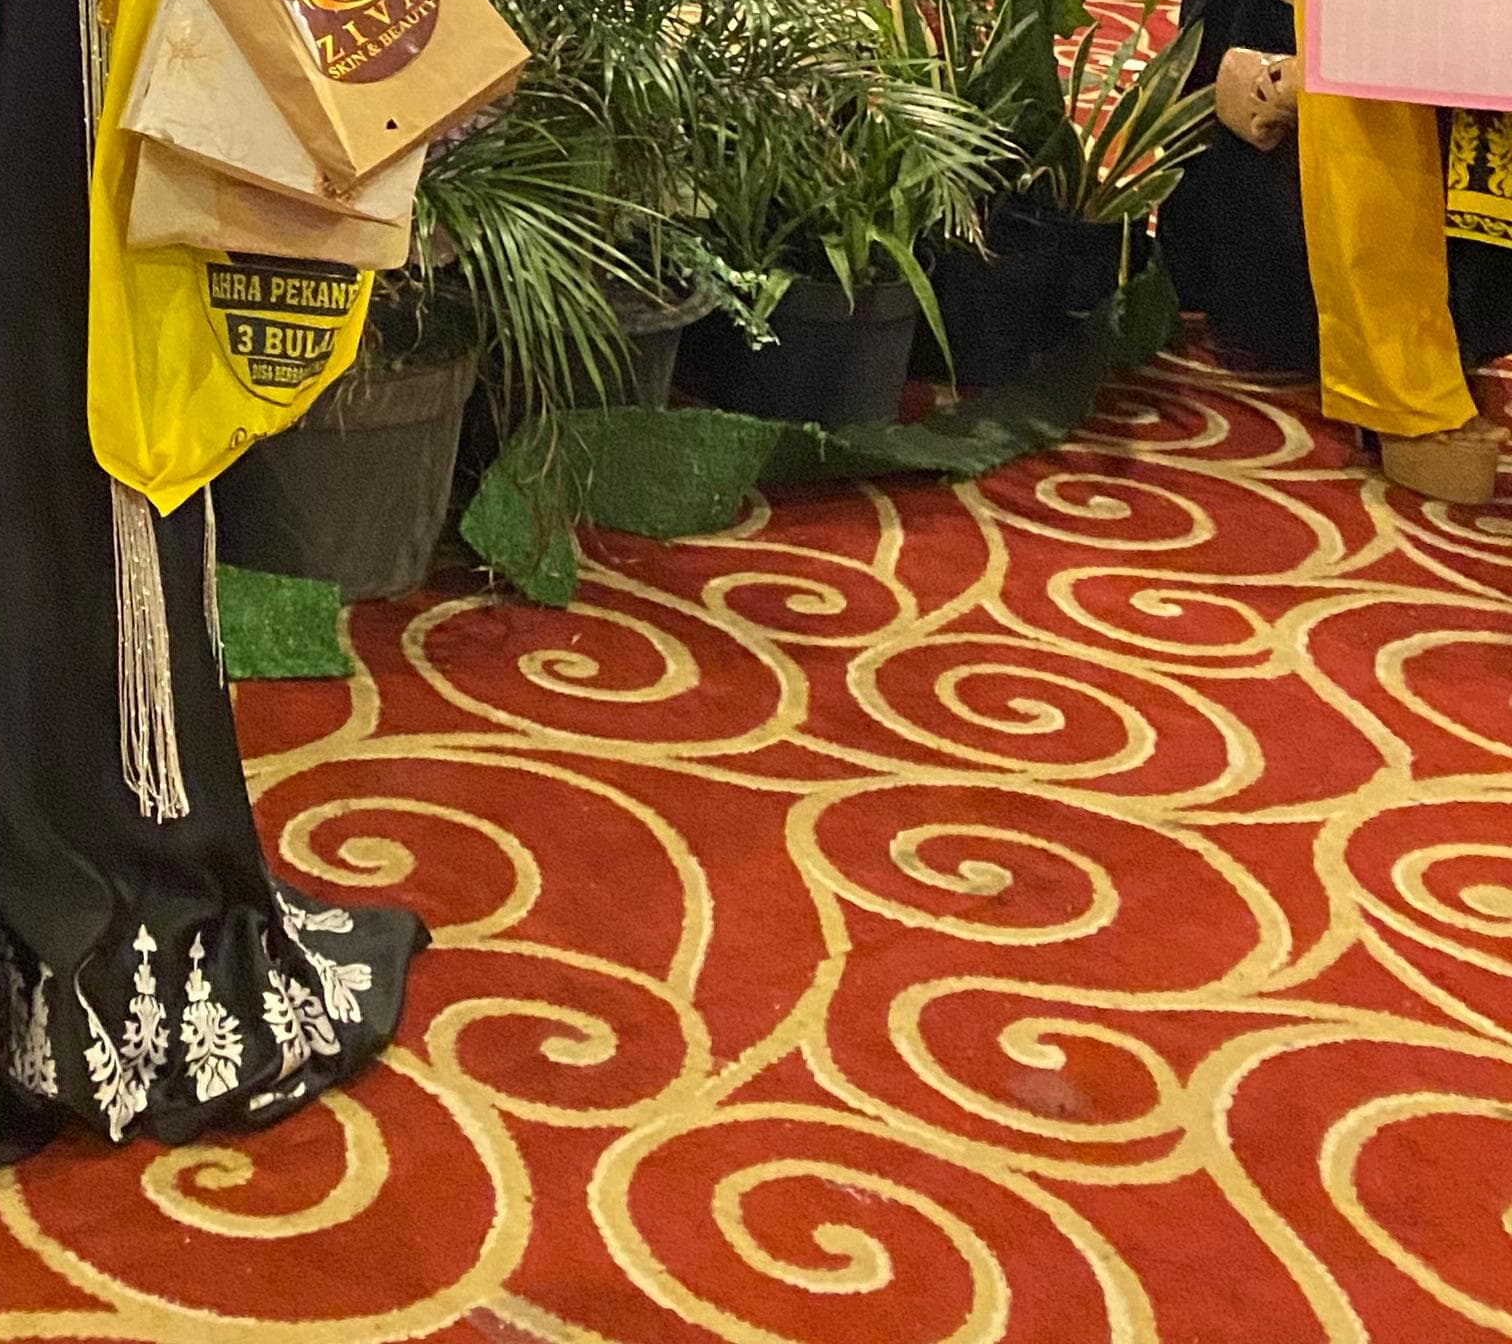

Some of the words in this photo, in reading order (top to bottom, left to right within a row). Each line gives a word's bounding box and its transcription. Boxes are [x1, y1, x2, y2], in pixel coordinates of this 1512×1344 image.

[329, 50, 369, 79] SKIN
[367, 41, 382, 57] &
[237, 323, 254, 354] 3
